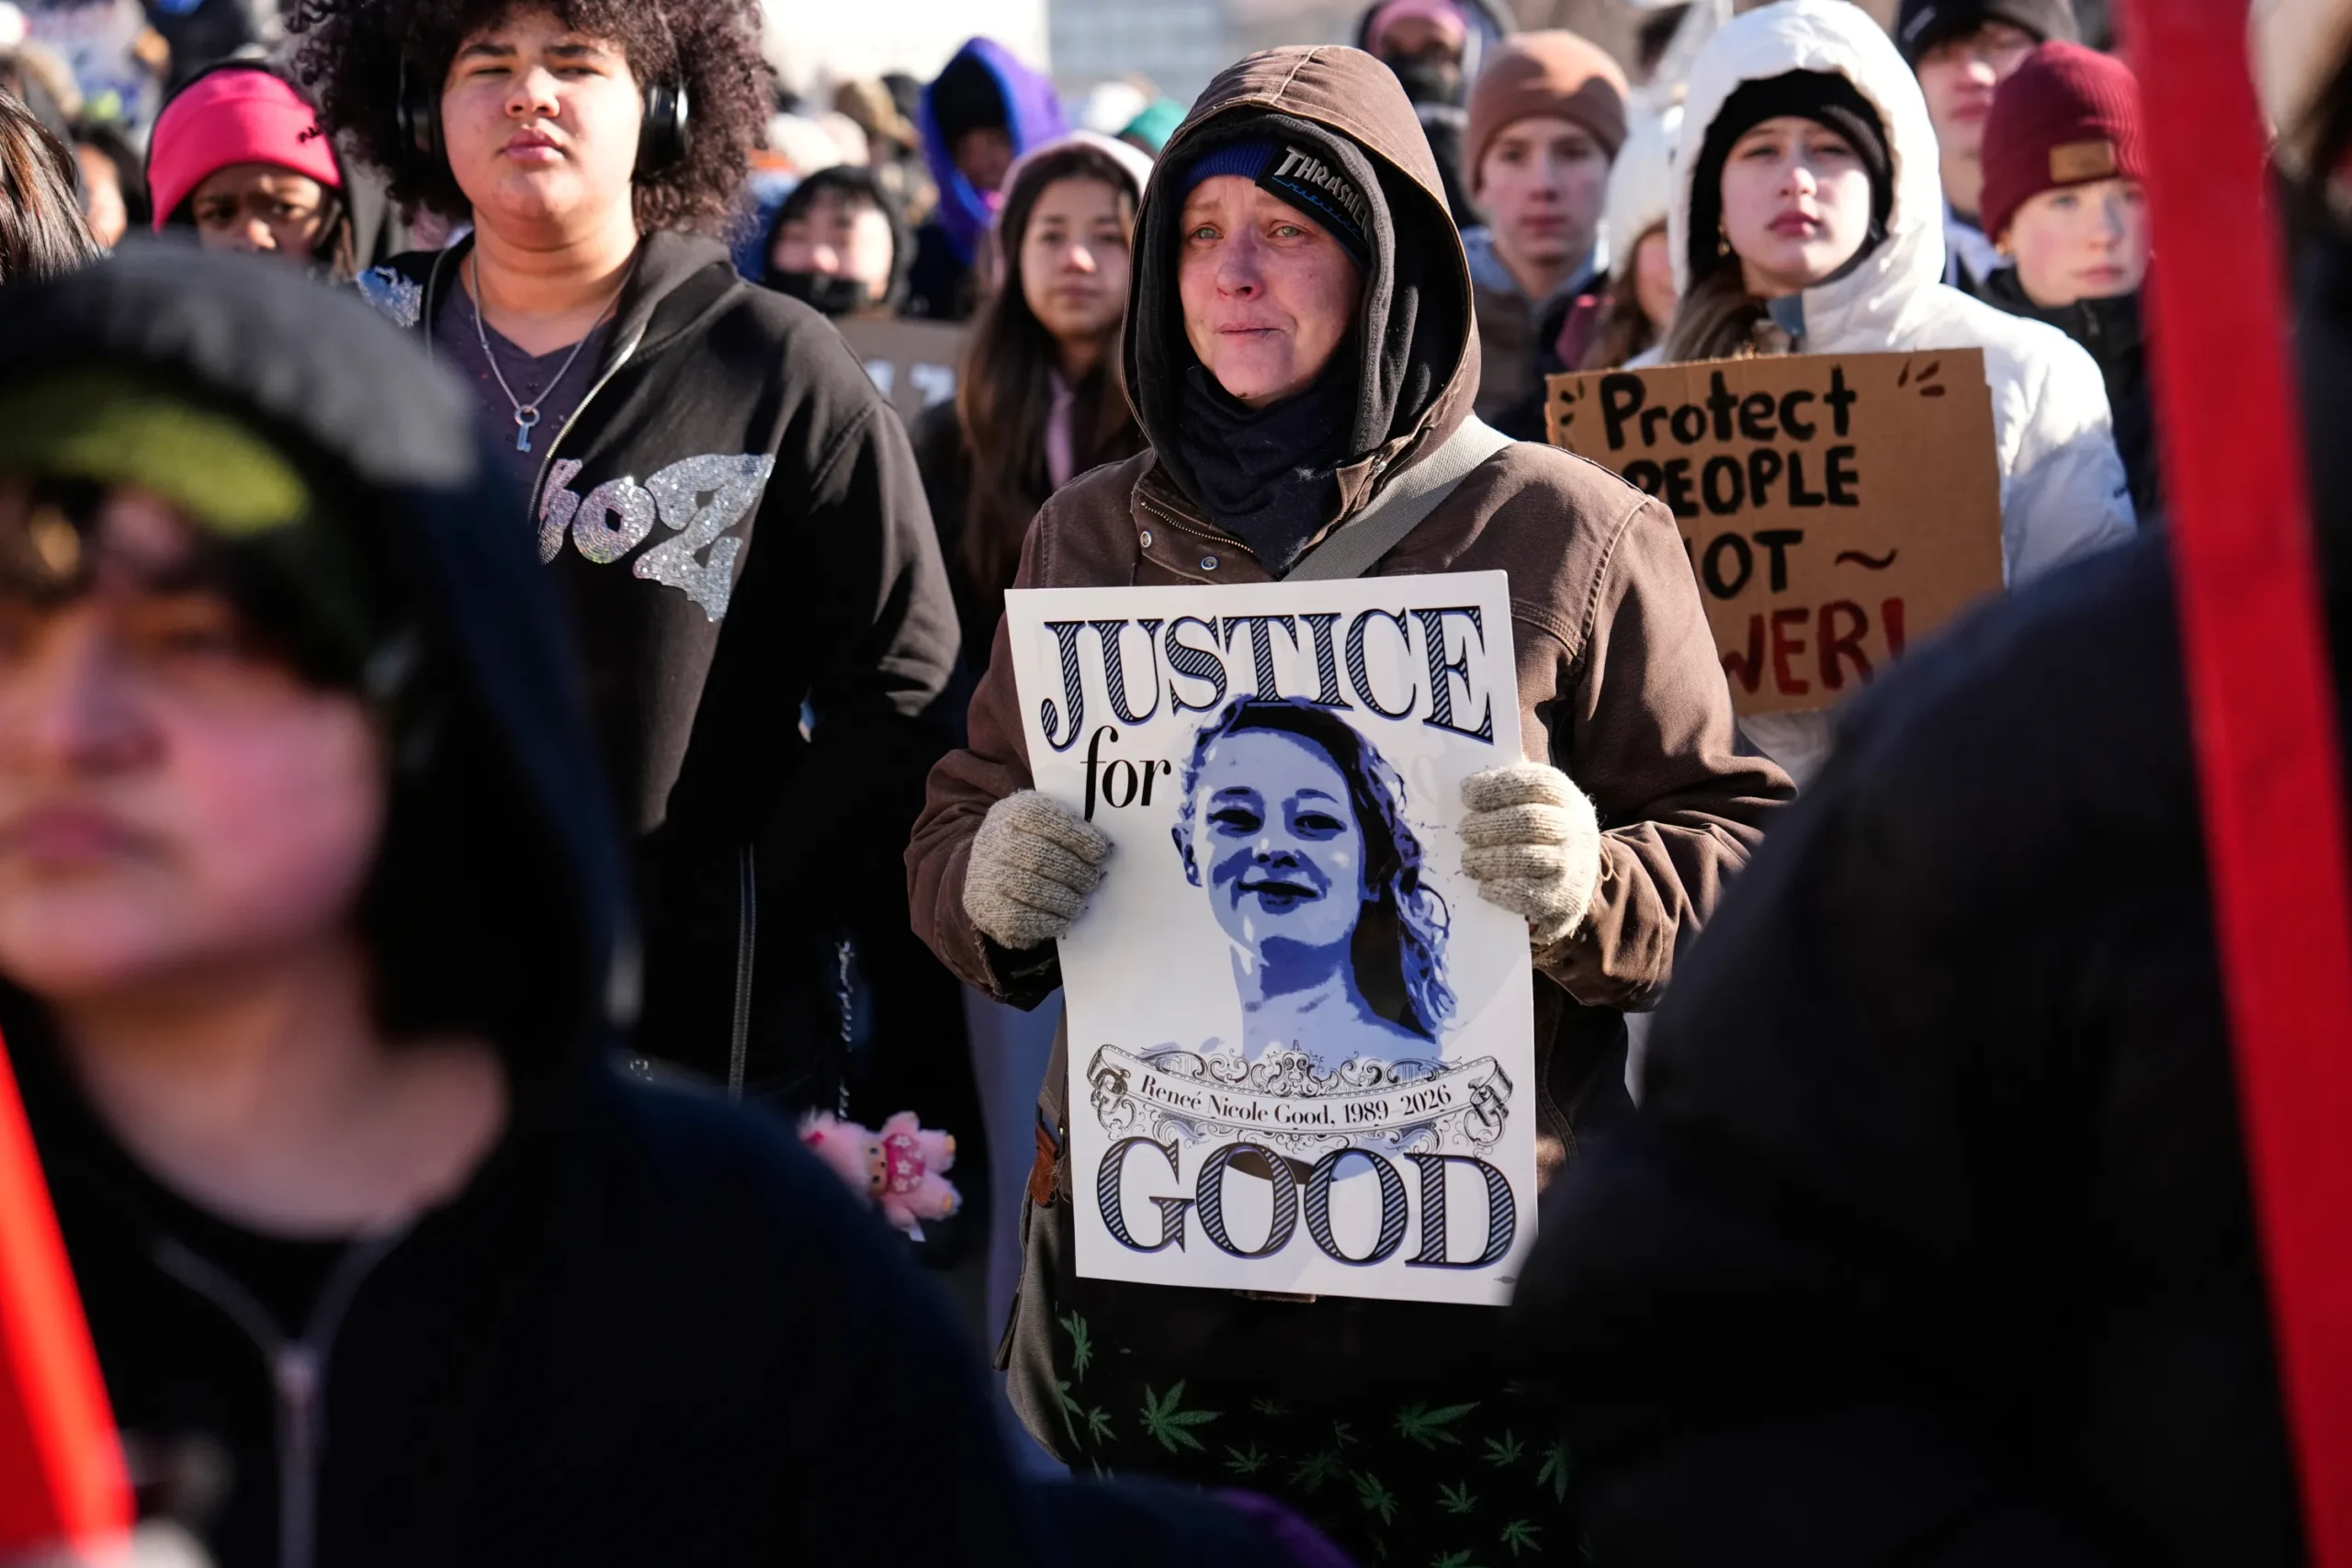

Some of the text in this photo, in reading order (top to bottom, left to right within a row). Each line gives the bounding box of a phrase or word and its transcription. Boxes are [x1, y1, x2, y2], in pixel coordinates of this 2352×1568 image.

[1599, 364, 1857, 450] Protect
[1622, 445, 1860, 517] PEOPLE
[1684, 530, 1804, 600] OT
[1041, 604, 1495, 751] JUSTICE
[1720, 597, 1905, 695] WER!
[1080, 725, 1171, 821] for
[1141, 1074, 1202, 1111] Reneé
[1207, 1094, 1269, 1122] Nicole
[1274, 1103, 1336, 1128] Good,
[1096, 1136, 1518, 1269] GOOD
